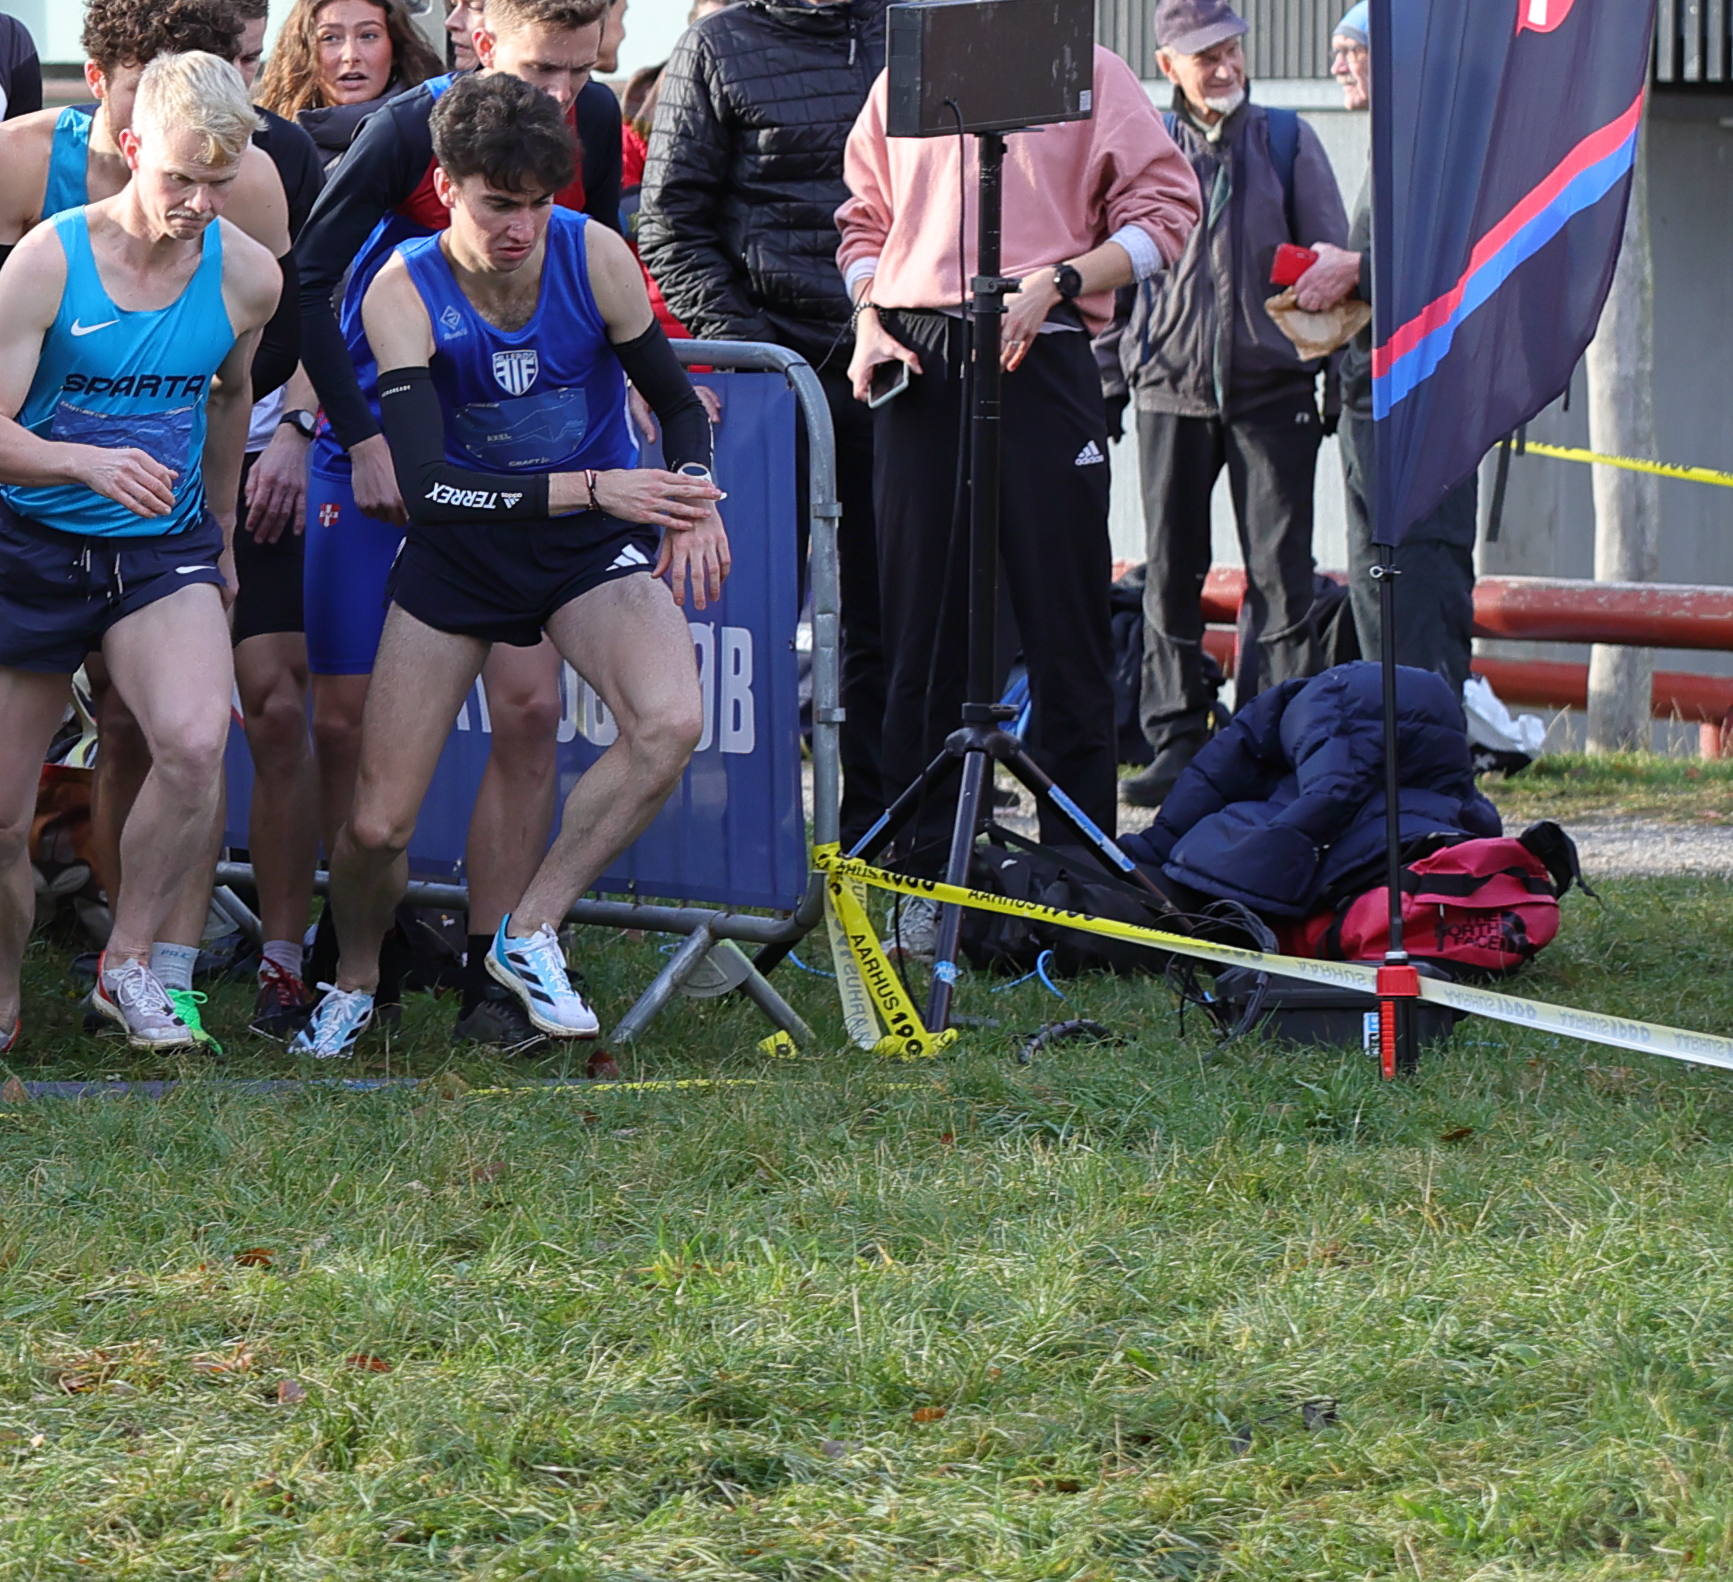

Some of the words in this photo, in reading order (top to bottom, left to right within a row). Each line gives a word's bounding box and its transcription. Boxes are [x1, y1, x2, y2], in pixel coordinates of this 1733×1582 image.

[62, 373, 207, 399] SPARTA
[1074, 454, 1105, 466] adidas
[425, 481, 498, 510] TERREX
